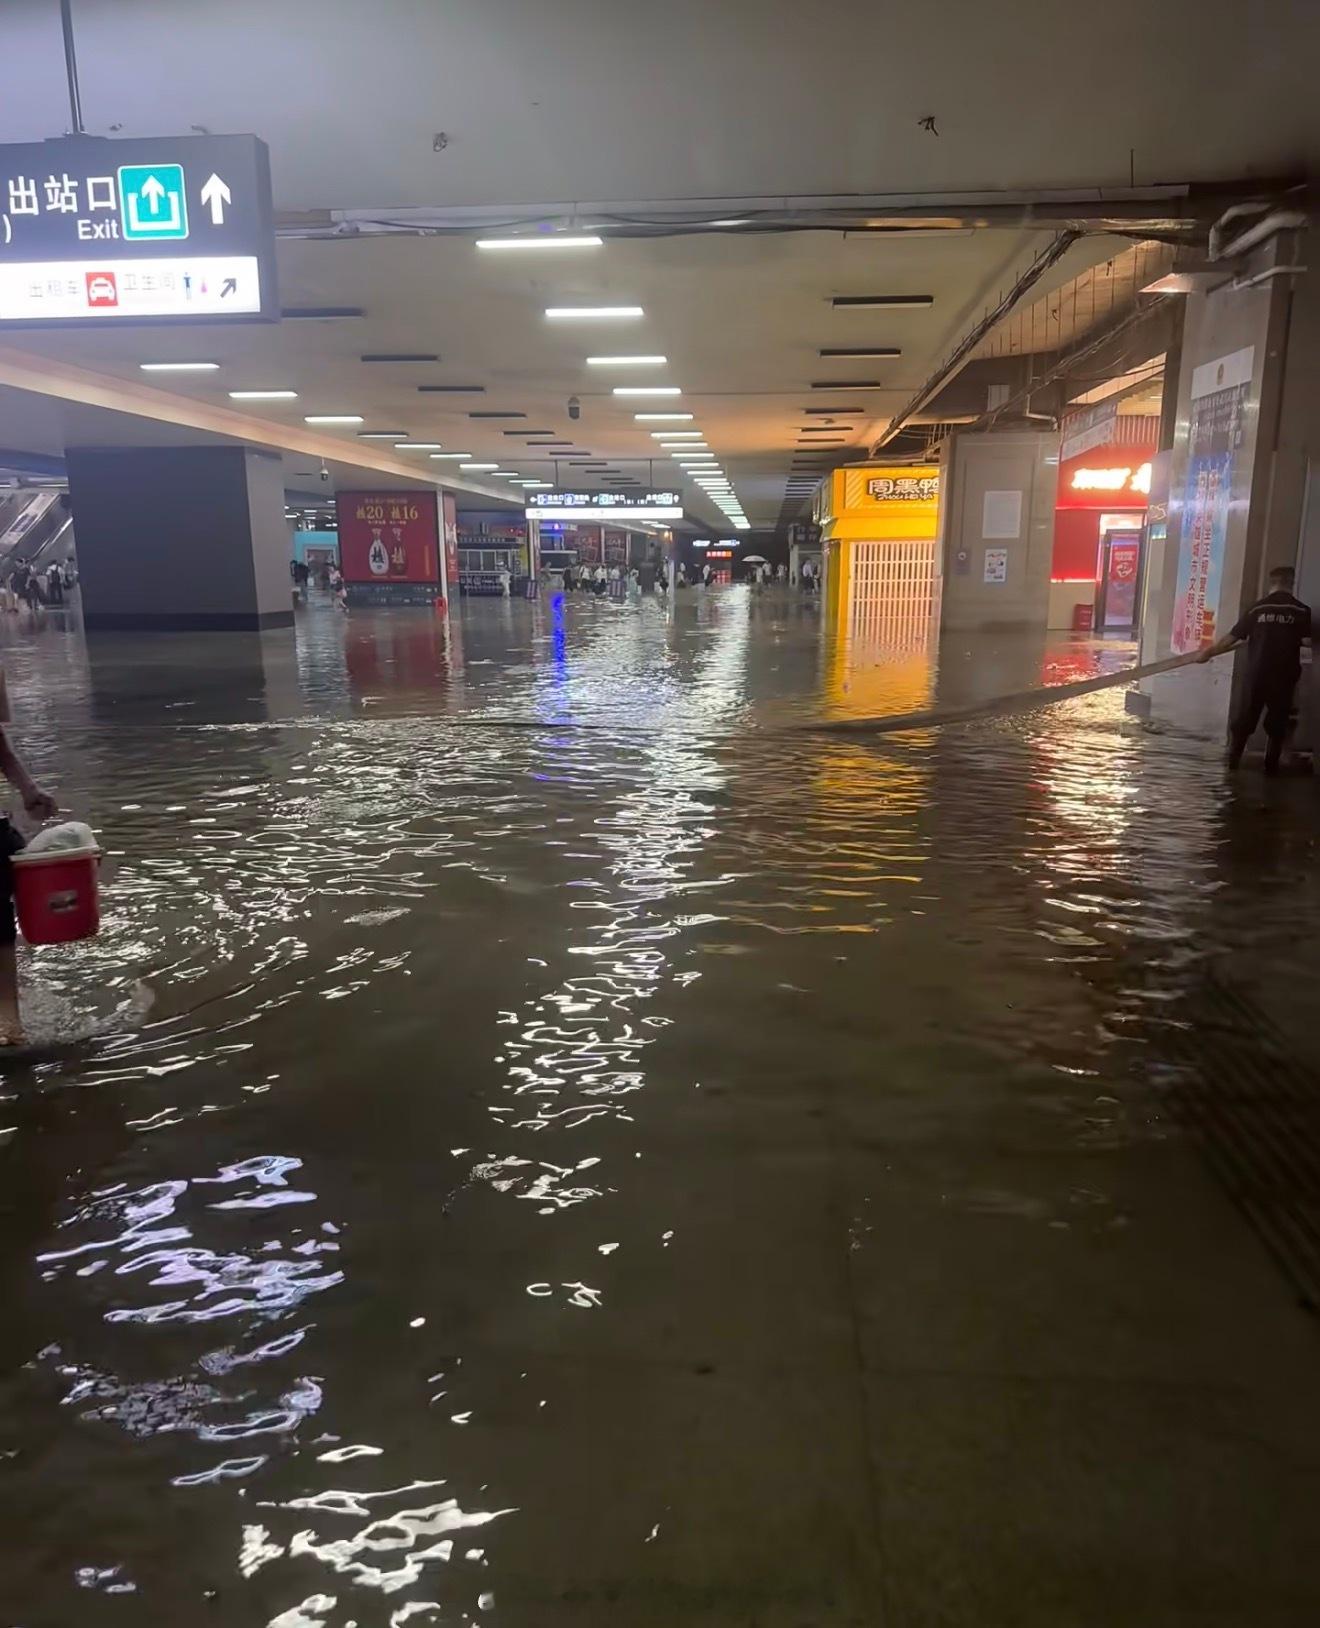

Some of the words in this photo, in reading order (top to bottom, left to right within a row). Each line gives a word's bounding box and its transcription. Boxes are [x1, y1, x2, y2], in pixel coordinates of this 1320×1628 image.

[8, 174, 117, 215] 出站口
[77, 219, 119, 240] Exit
